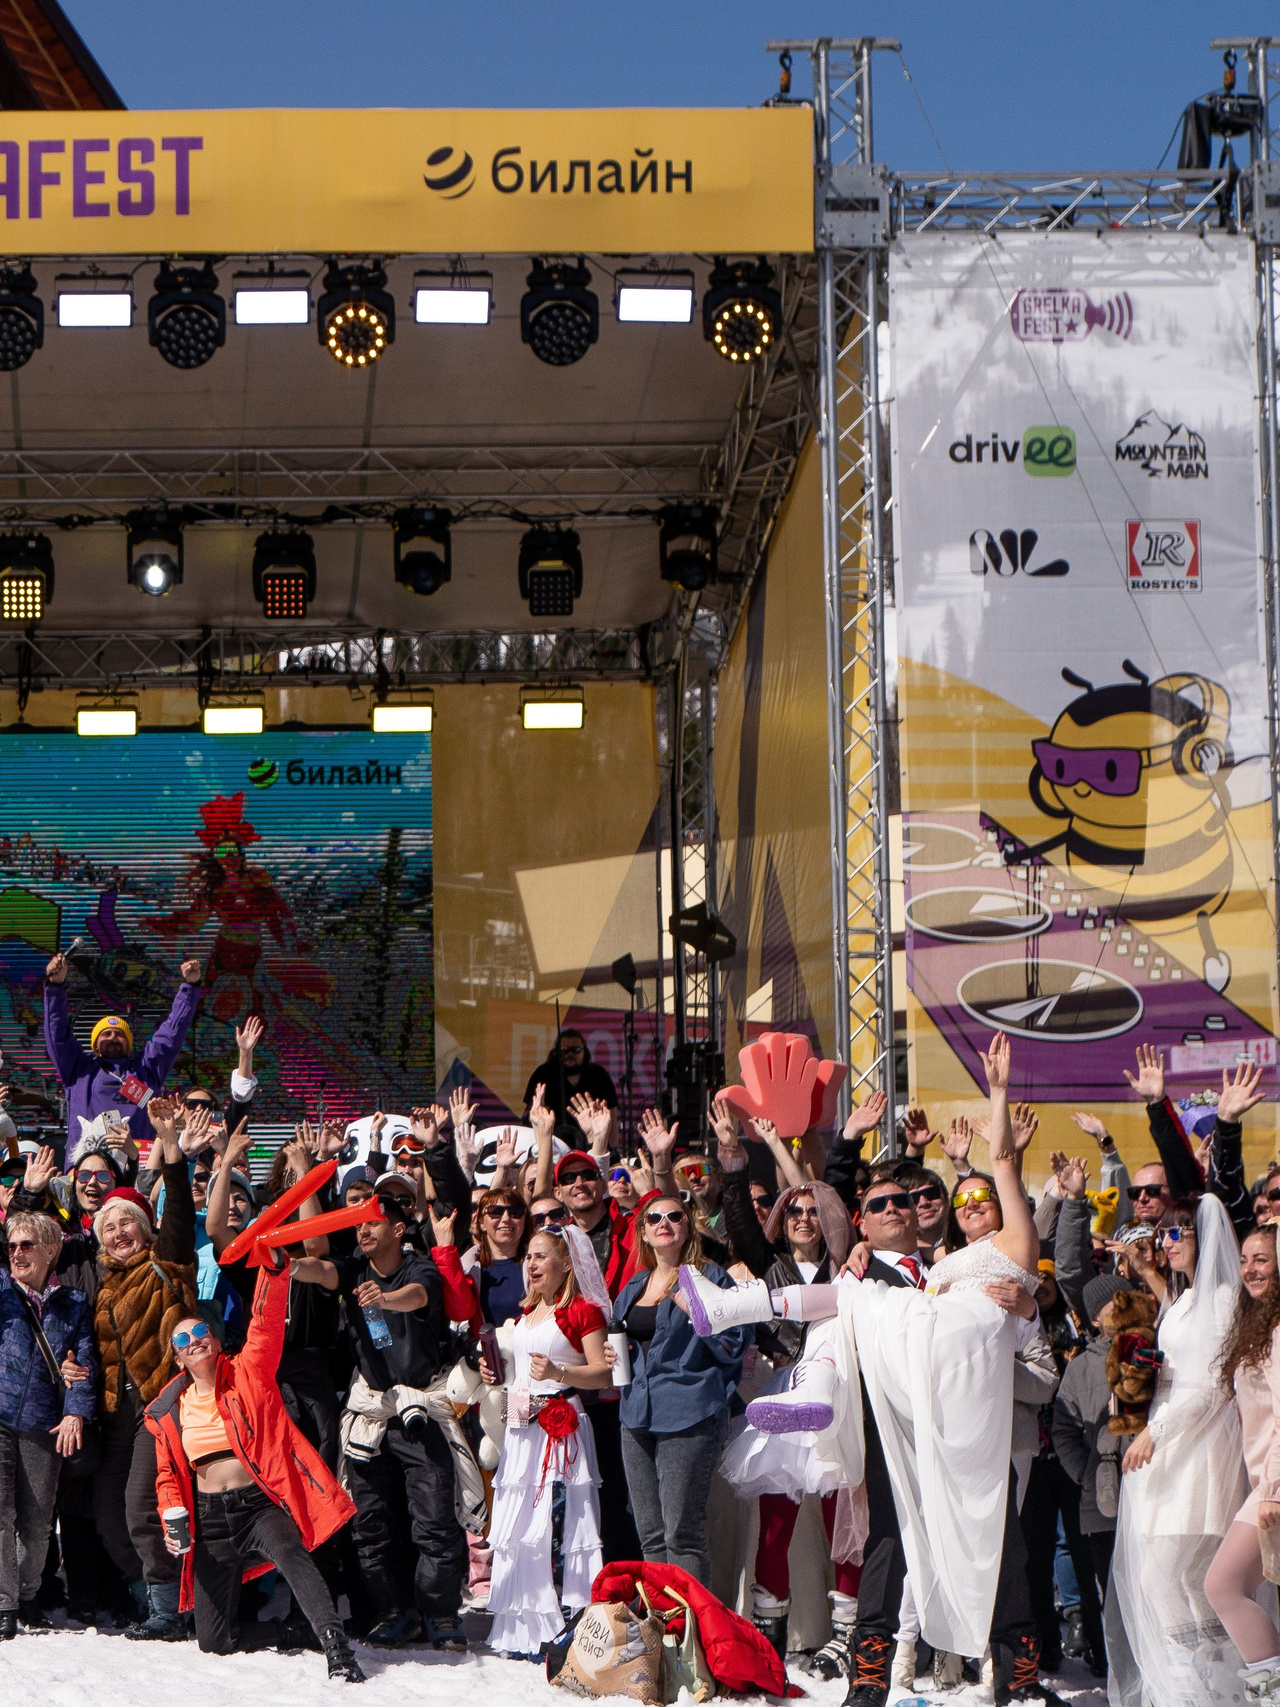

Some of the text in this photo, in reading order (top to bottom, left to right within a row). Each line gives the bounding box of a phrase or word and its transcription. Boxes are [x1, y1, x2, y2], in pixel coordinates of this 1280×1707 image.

[491, 146, 694, 196] билайн
[1023, 296, 1081, 315] GRELKA
[1023, 317, 1064, 335] FEST
[948, 433, 1077, 467] drivee
[1115, 443, 1206, 462] MOUNTAIN
[1166, 463, 1209, 479] MAN
[1131, 578, 1198, 590] ROSTIC'S
[286, 759, 403, 785] билайн
